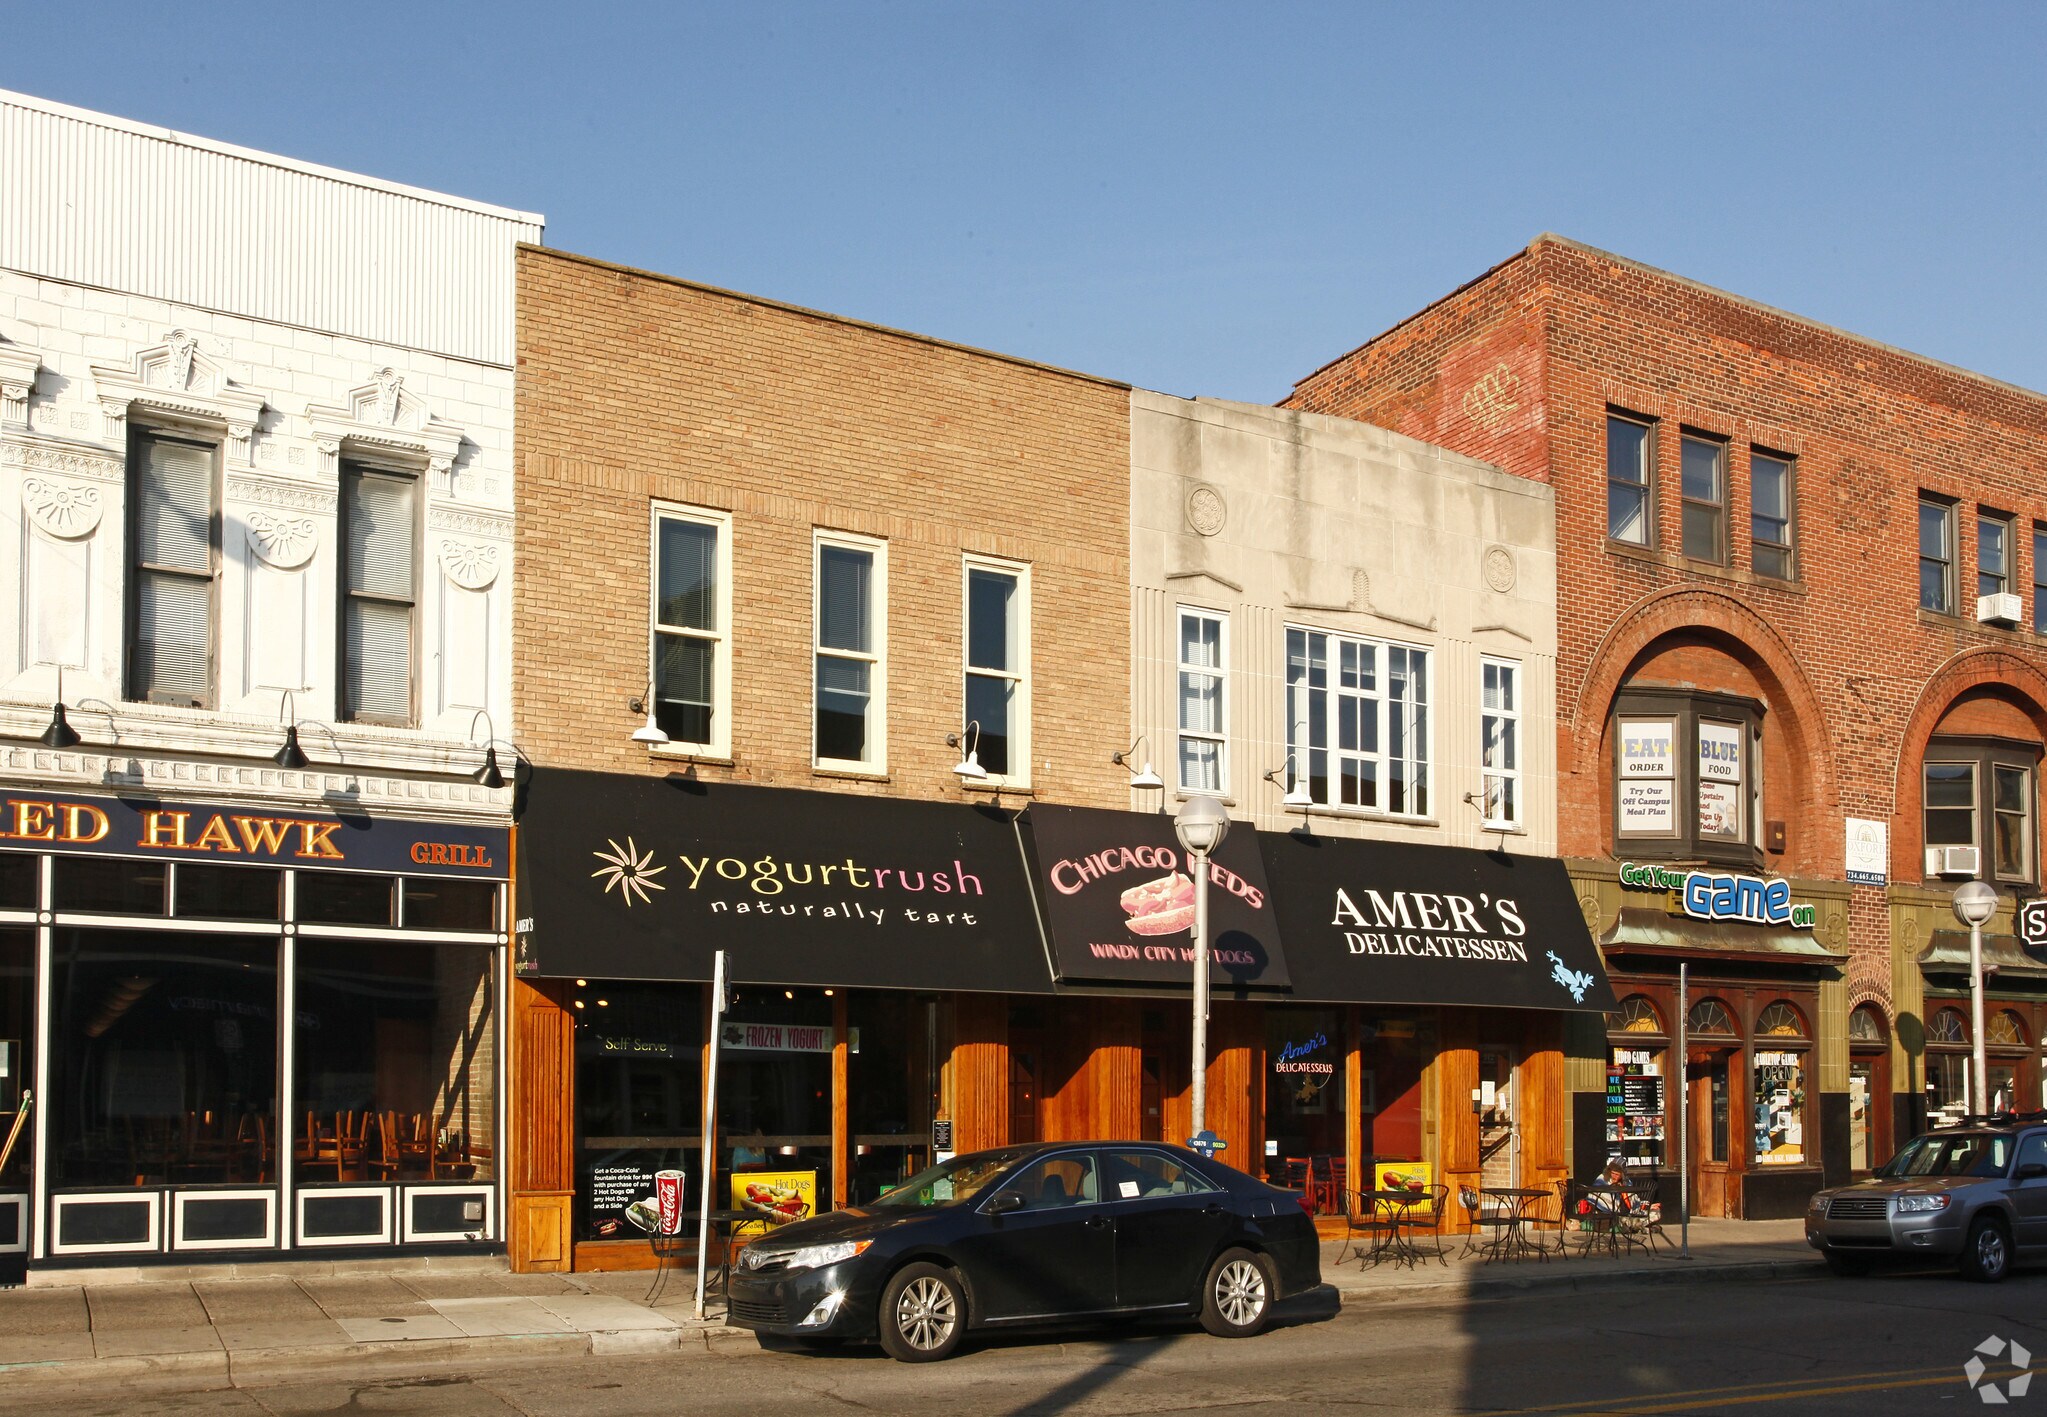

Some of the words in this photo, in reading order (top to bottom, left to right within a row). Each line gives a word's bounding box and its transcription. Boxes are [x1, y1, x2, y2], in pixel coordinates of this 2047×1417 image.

[1624, 738, 1669, 758] EAT
[1700, 739, 1738, 762] BLUE
[1629, 763, 1664, 772] ORDER
[1708, 764, 1732, 775] FOOD
[1629, 787, 1644, 796] Try
[1646, 787, 1663, 795] Our
[1622, 797, 1637, 805] Off
[1638, 797, 1670, 806] Campus
[1626, 808, 1646, 816] Meal
[1647, 808, 1666, 816] Plan
[1713, 813, 1723, 823] Up
[0, 799, 110, 844] ED
[137, 809, 345, 860] HAWK
[410, 841, 493, 868] GRILL
[1847, 840, 1886, 855] OXFORD
[679, 855, 984, 895] yogurtrush
[1050, 845, 1178, 895] CHICAGO
[1847, 871, 1885, 882] 734.665.6500
[1621, 863, 1651, 886] Get
[1650, 866, 1687, 888] Your
[1685, 874, 1791, 921] Game
[1792, 905, 1816, 926] on
[711, 900, 885, 925] naturally
[904, 908, 977, 925] tart
[1331, 887, 1527, 937] AMER'S
[1089, 942, 1140, 960] WINDY
[1143, 946, 1177, 962] CITY
[1214, 949, 1256, 965] DOGS
[1343, 932, 1529, 963] DELICATESSEN
[605, 1037, 631, 1050] Self
[633, 1038, 667, 1052] Serve
[746, 1026, 783, 1049] FROZEN
[787, 1027, 824, 1050] YOGURT
[1280, 1032, 1327, 1059] Amer's
[1632, 1051, 1651, 1064] GAMES
[1781, 1053, 1798, 1066] GAMES
[1609, 1076, 1620, 1084] WE
[1763, 1065, 1792, 1080] OPEN
[1608, 1085, 1621, 1093] BUY
[1607, 1095, 1624, 1103] USED
[775, 1179, 788, 1190] Hot
[790, 1178, 811, 1191] Dogs
